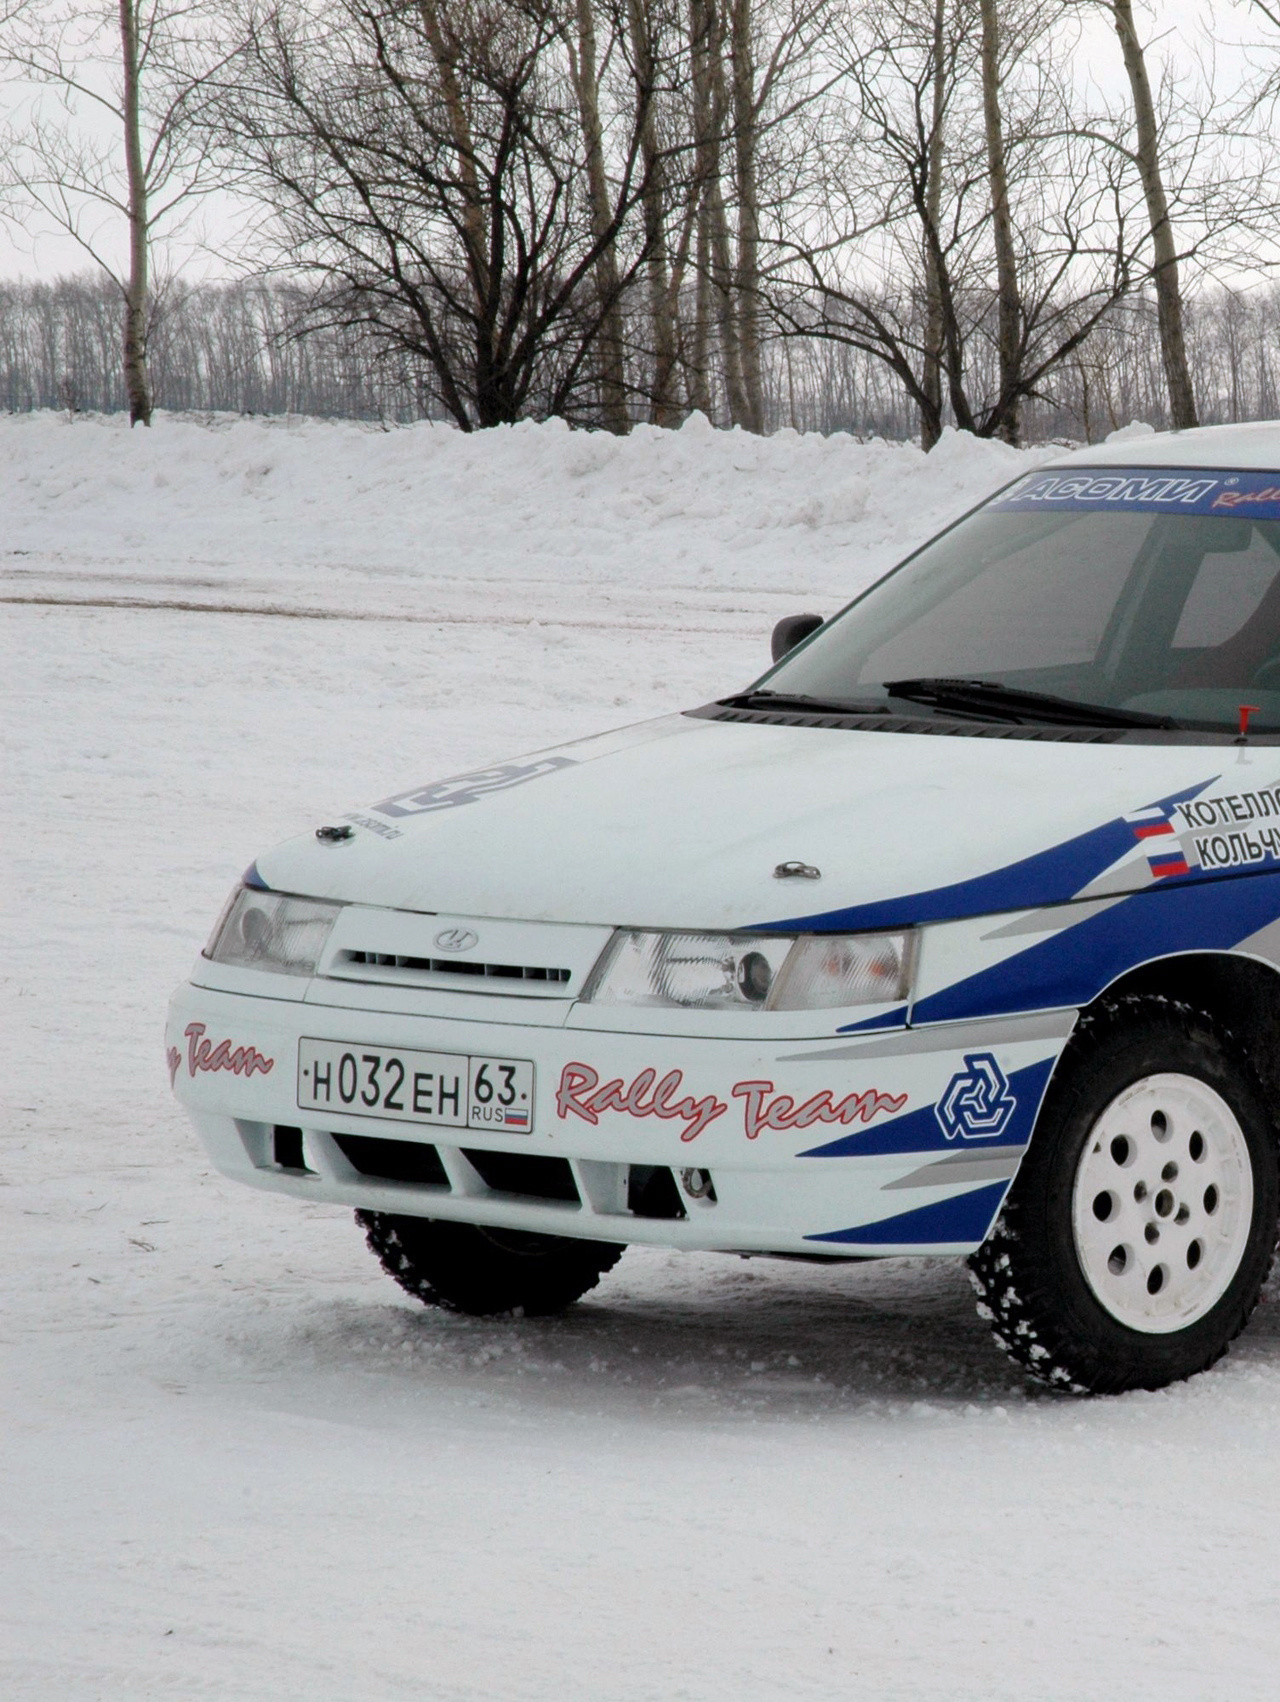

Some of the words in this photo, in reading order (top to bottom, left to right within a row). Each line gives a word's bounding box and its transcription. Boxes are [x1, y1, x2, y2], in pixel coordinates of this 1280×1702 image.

[184, 1022, 275, 1078] Team
[473, 1063, 517, 1106] 63
[555, 1061, 729, 1142] Rally
[731, 1079, 909, 1139] Team
[471, 1105, 504, 1123] RUS
